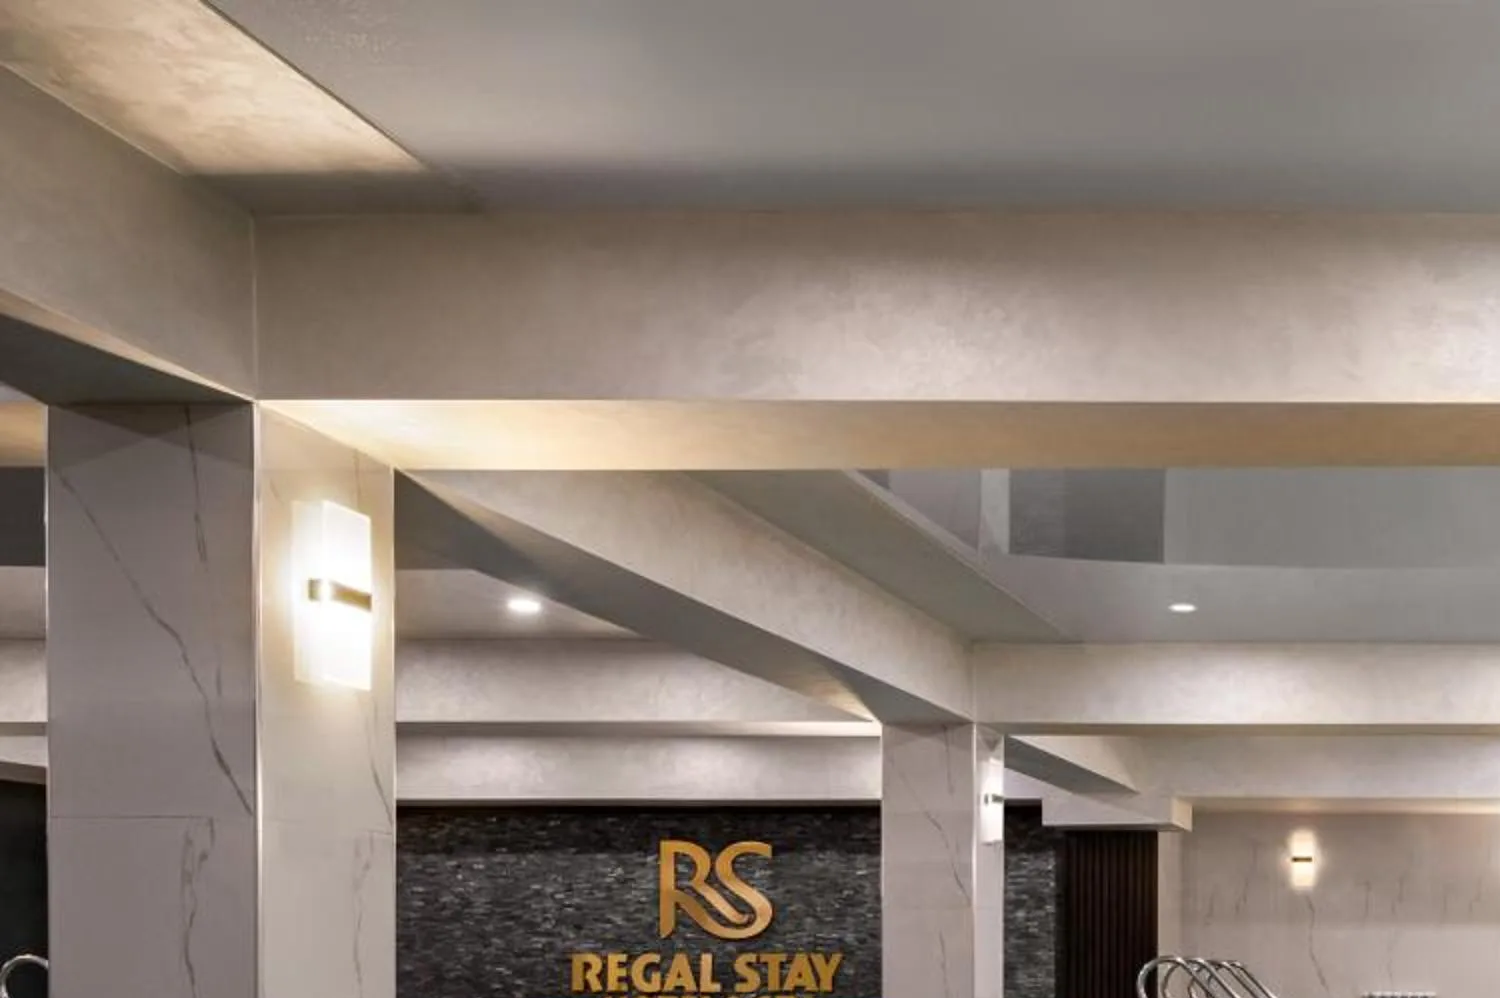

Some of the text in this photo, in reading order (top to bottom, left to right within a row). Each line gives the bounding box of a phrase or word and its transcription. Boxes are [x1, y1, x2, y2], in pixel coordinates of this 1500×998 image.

[658, 839, 773, 940] RS
[570, 952, 843, 993] REGAL STAY
